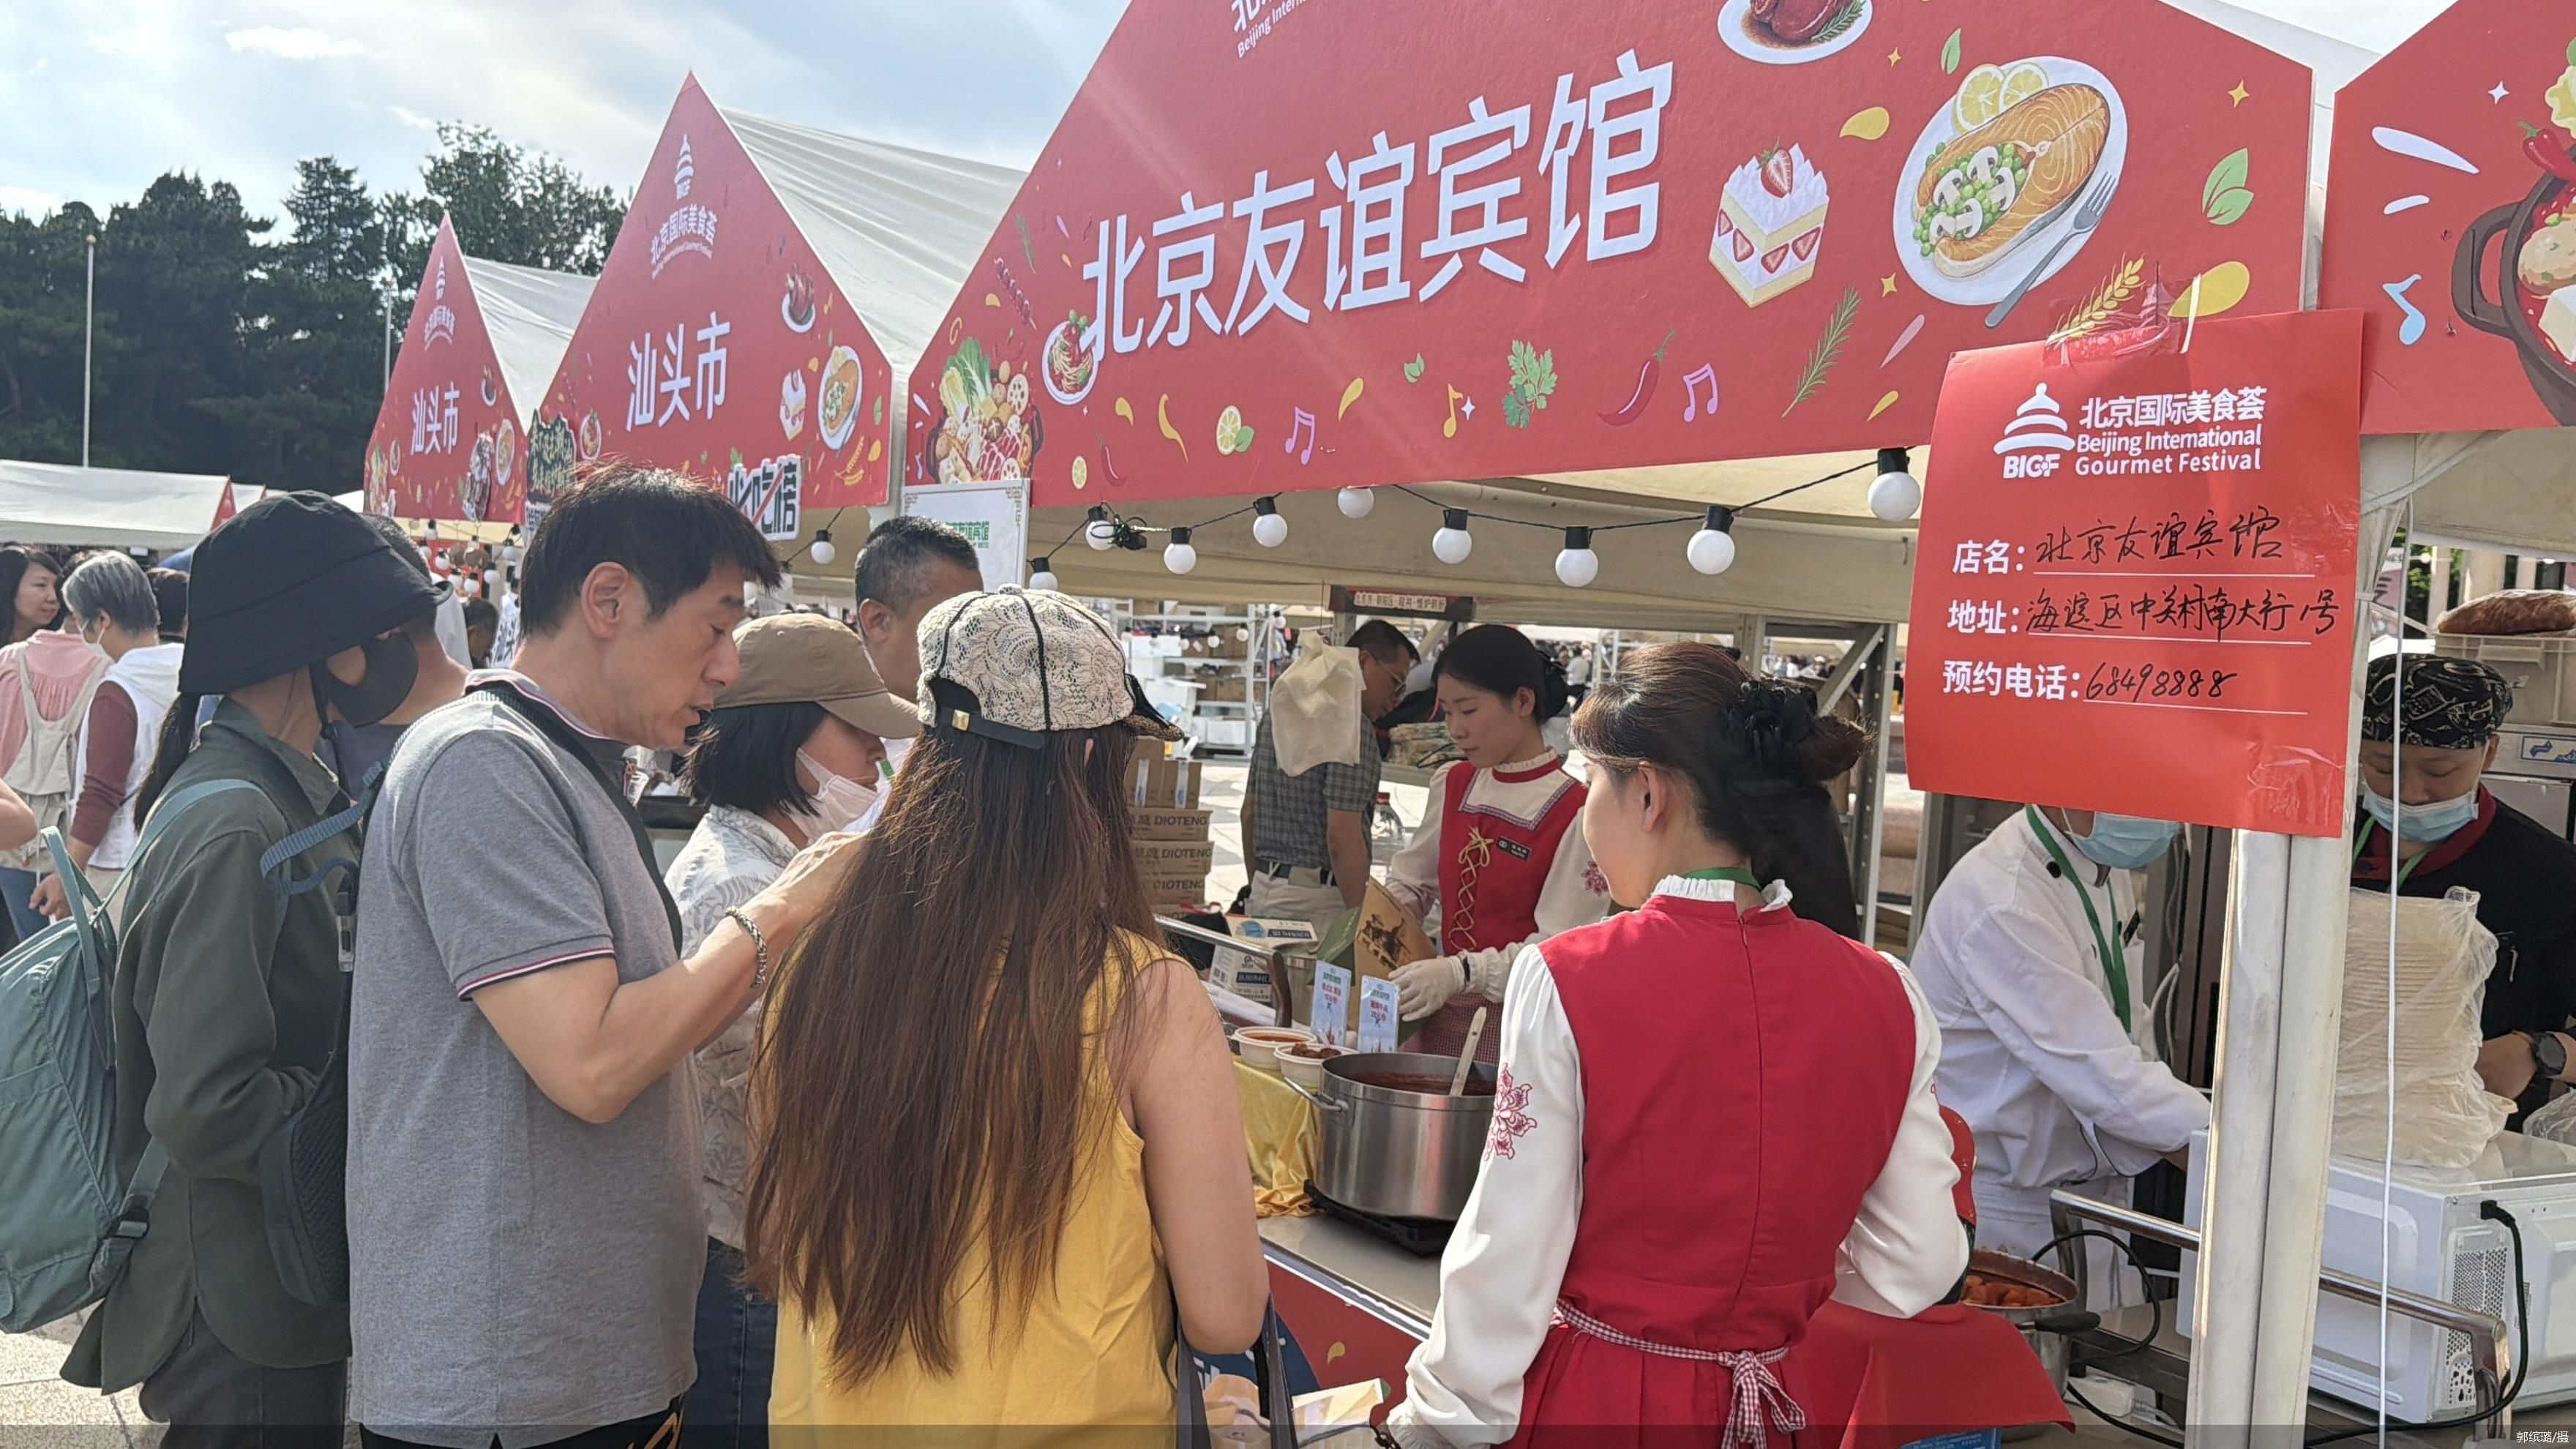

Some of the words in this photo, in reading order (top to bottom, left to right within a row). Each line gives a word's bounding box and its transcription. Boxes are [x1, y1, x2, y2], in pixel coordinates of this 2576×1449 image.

[1238, 15, 1271, 59] Beijing
[1079, 48, 1674, 362] 北京友谊宾馆
[626, 311, 730, 432] 汕头市
[411, 381, 460, 456] 汕头市
[2079, 386, 2267, 430] 北京国际美食荟
[2075, 454, 2172, 476] Gourmet
[2179, 448, 2261, 473] Festival
[2077, 432, 2142, 457] Beijing
[2145, 423, 2262, 451] International
[2034, 505, 2283, 564] 北京友谊宾馆
[2085, 662, 2236, 703] 68498888
[1154, 815, 1207, 825] DIOTENG
[1161, 848, 1212, 859] DIOTENG
